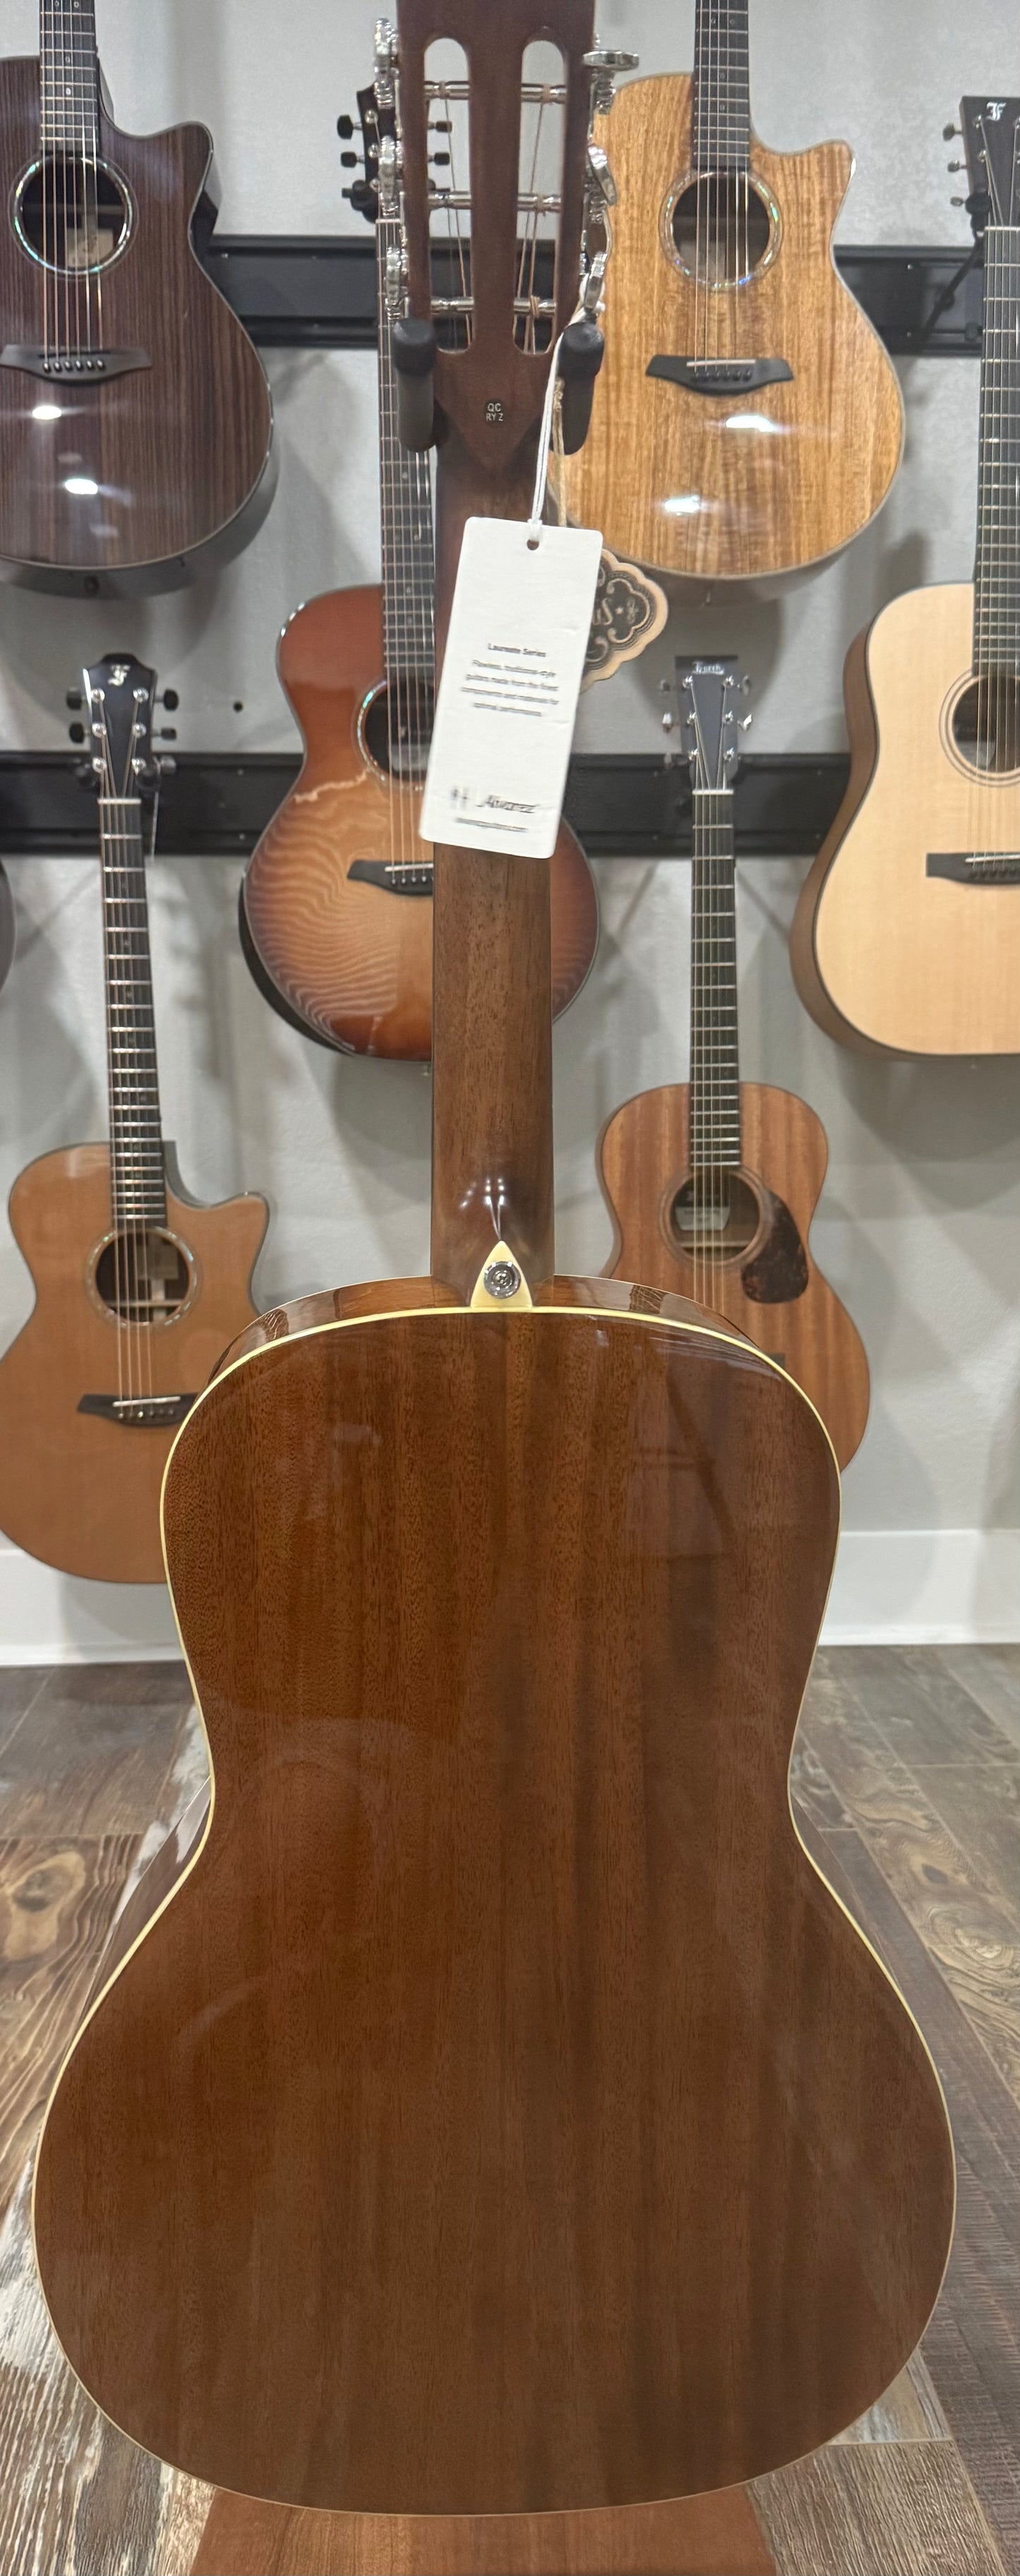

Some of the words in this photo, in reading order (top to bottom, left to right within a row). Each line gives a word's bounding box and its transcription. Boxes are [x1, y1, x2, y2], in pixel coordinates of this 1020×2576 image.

[487, 402, 501, 412] QC
[486, 412, 496, 421] RY
[498, 413, 503, 421] Z
